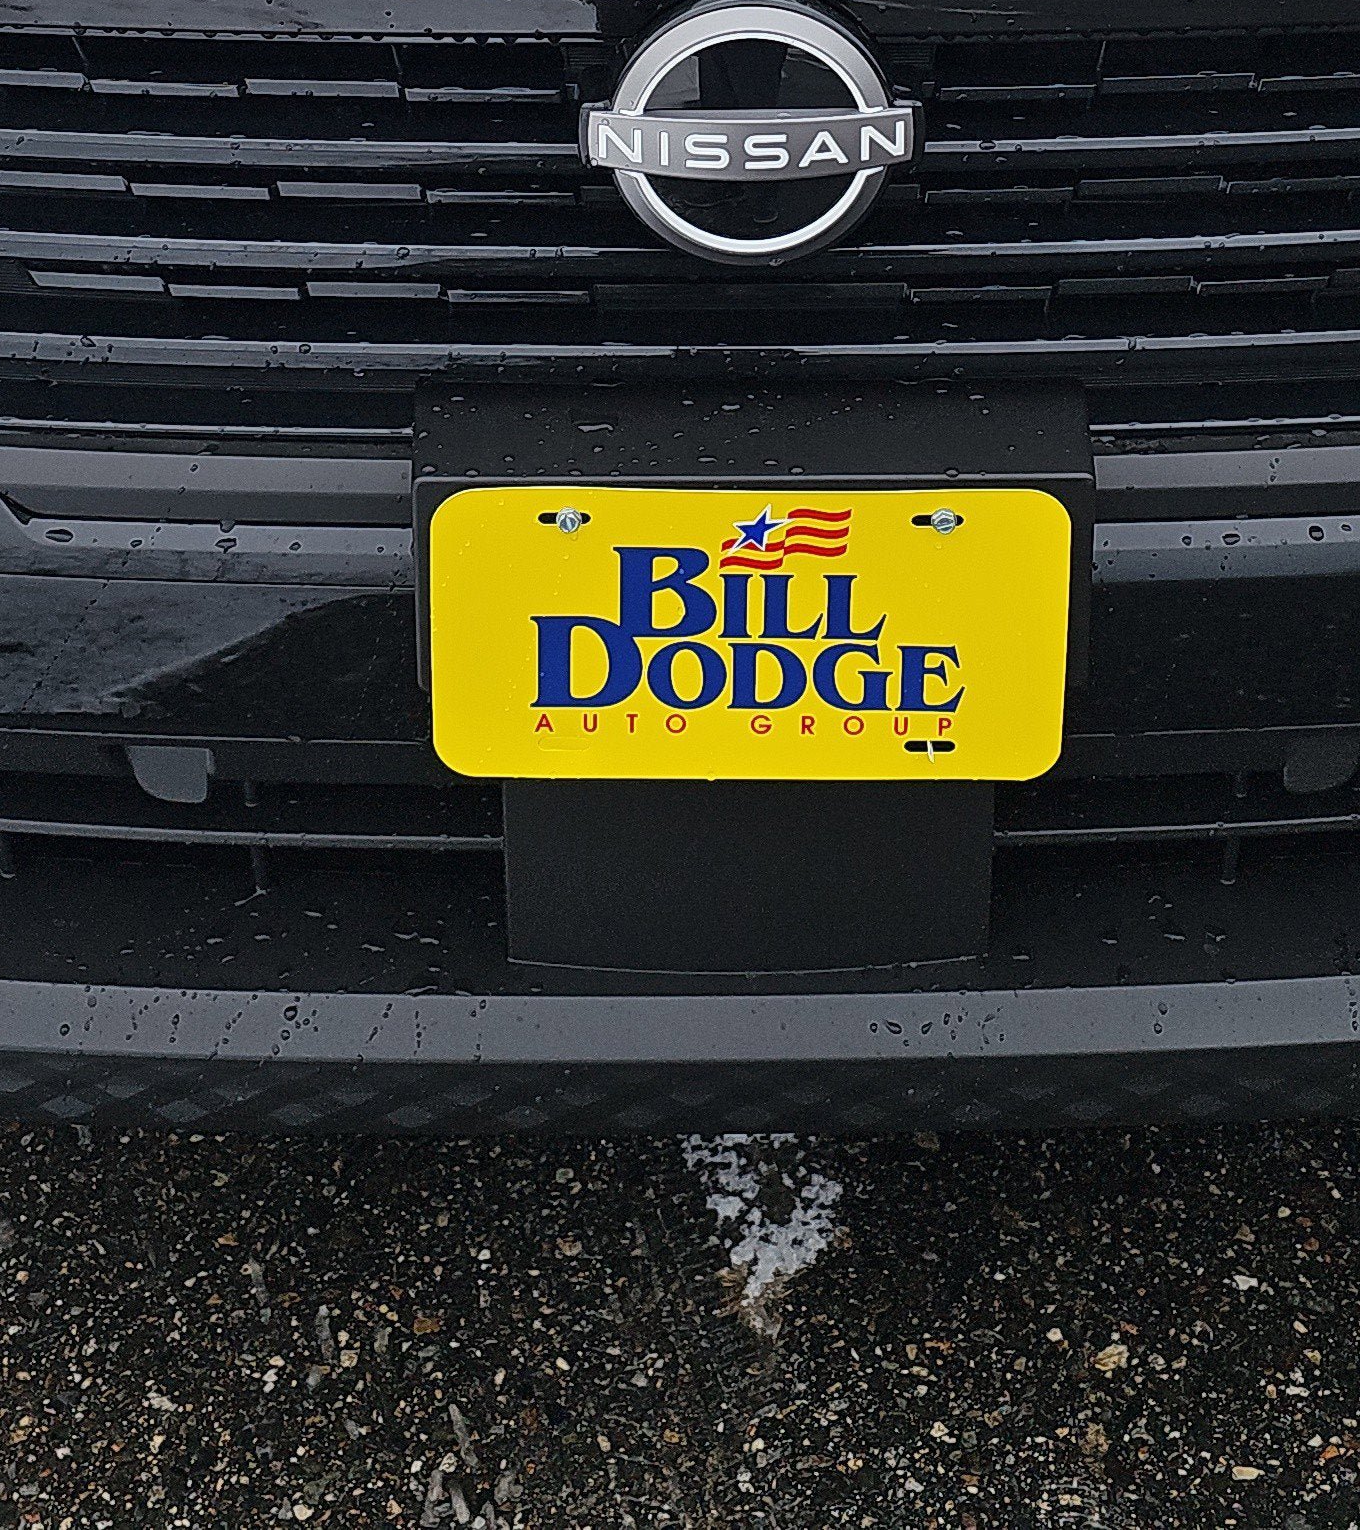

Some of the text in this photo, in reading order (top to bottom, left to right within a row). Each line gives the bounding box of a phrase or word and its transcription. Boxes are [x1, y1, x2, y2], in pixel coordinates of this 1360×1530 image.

[598, 120, 905, 170] NISSAN
[612, 546, 887, 640] BILL
[530, 616, 965, 713] DODGE
[534, 713, 954, 737] AUTO GROUP
